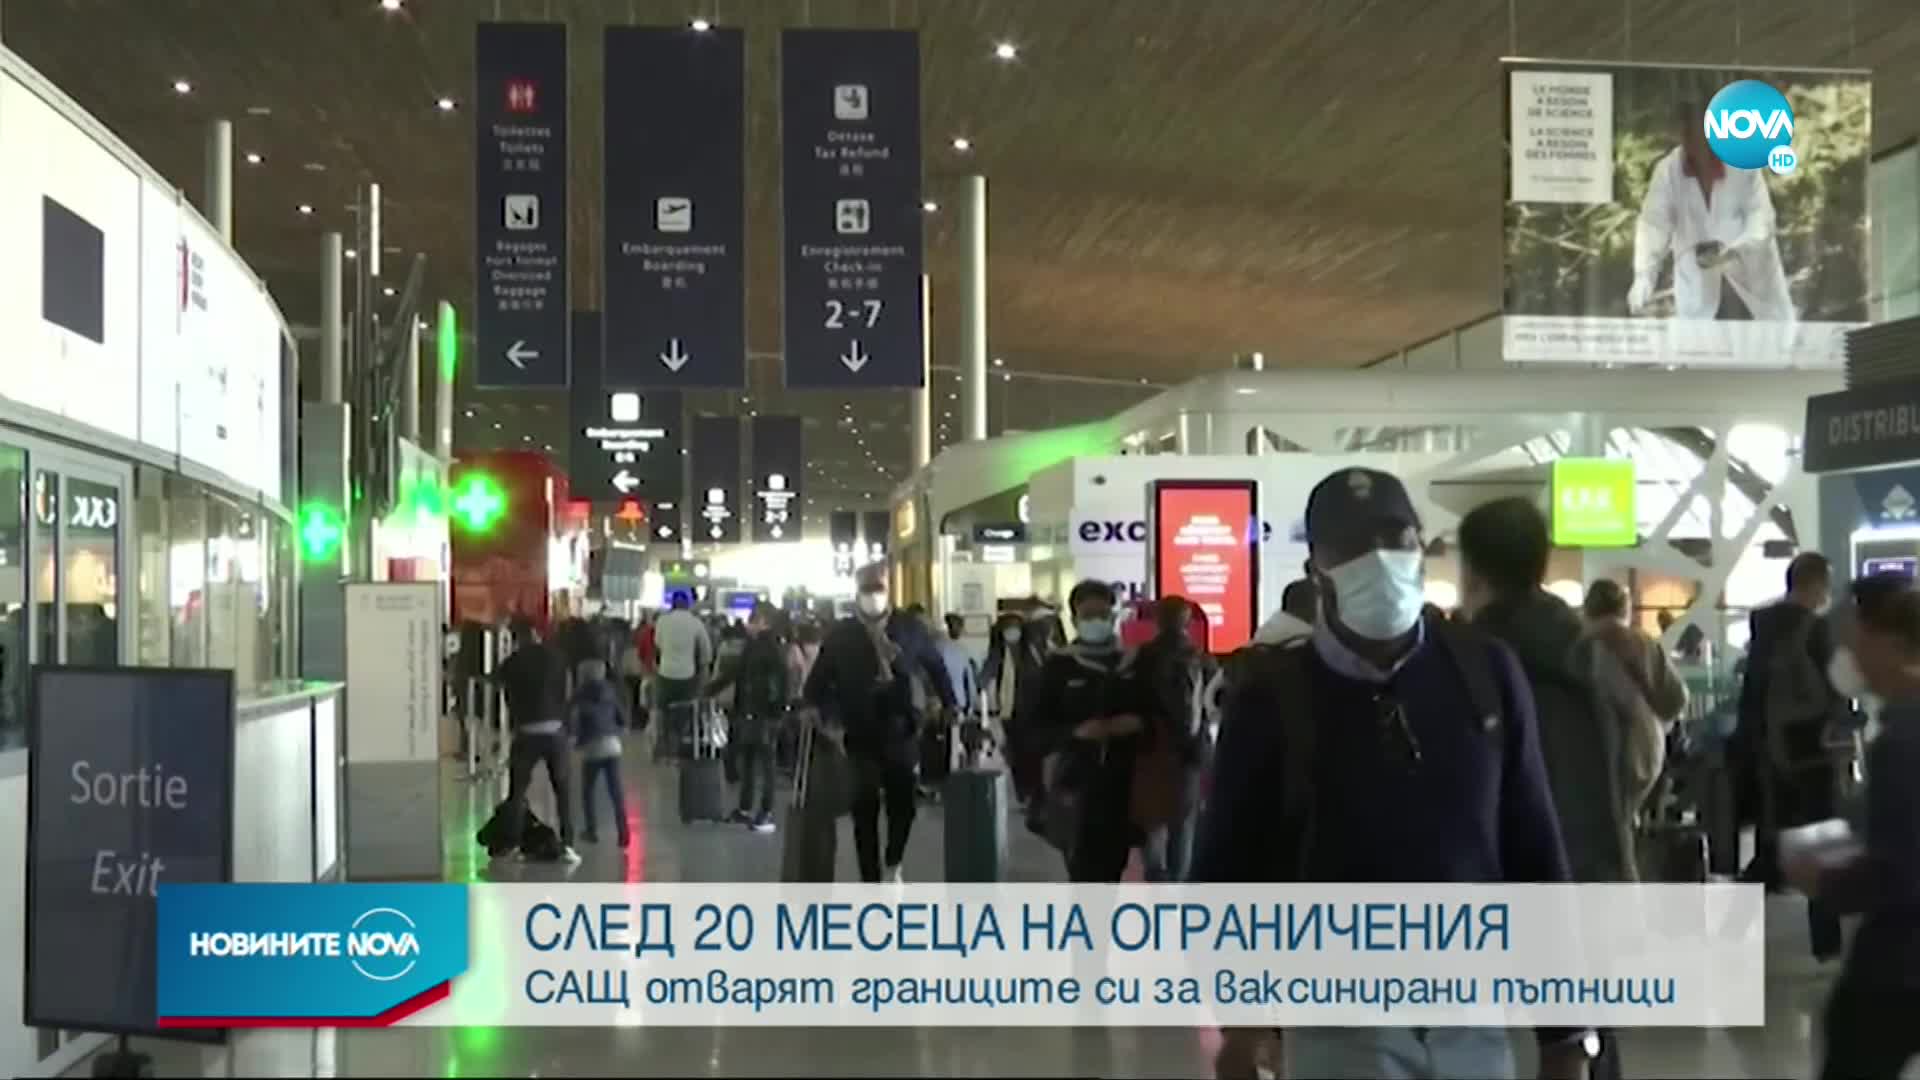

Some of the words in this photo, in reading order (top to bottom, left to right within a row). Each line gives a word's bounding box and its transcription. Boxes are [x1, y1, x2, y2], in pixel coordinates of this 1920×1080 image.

[824, 299, 882, 329] 2-7
[70, 760, 188, 809] Sortie
[91, 850, 166, 897] Exit
